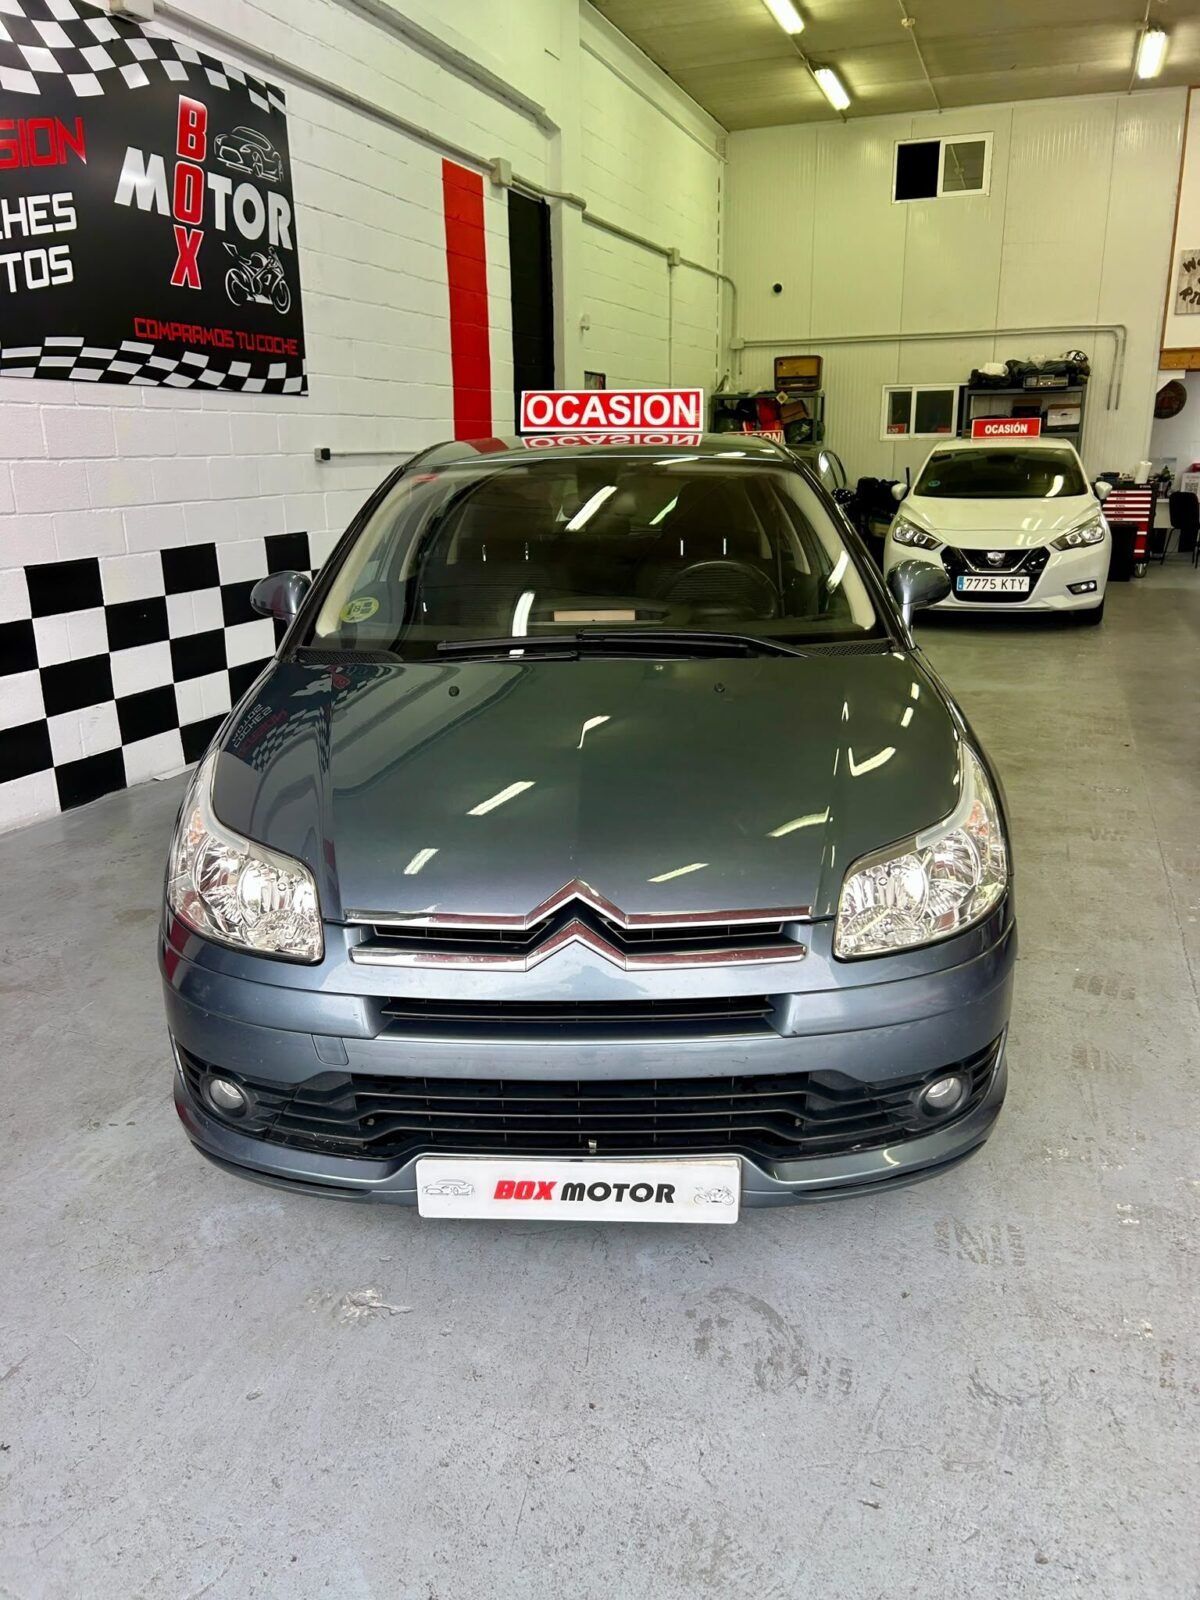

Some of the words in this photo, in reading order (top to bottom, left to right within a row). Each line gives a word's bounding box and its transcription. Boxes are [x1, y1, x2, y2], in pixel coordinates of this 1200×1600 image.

[170, 94, 208, 290] BOX
[0, 192, 77, 240] HES
[0, 244, 74, 293] TOS
[134, 317, 235, 349] COMPRAMOS
[236, 331, 255, 351] TU
[256, 334, 299, 356] COCHE
[526, 394, 696, 425] OCASION
[984, 422, 1028, 435] OCASIÓN
[966, 578, 997, 590] 7775
[1001, 579, 1025, 590] KTY
[493, 1180, 557, 1201] BOX
[560, 1182, 675, 1204] MOTOR
